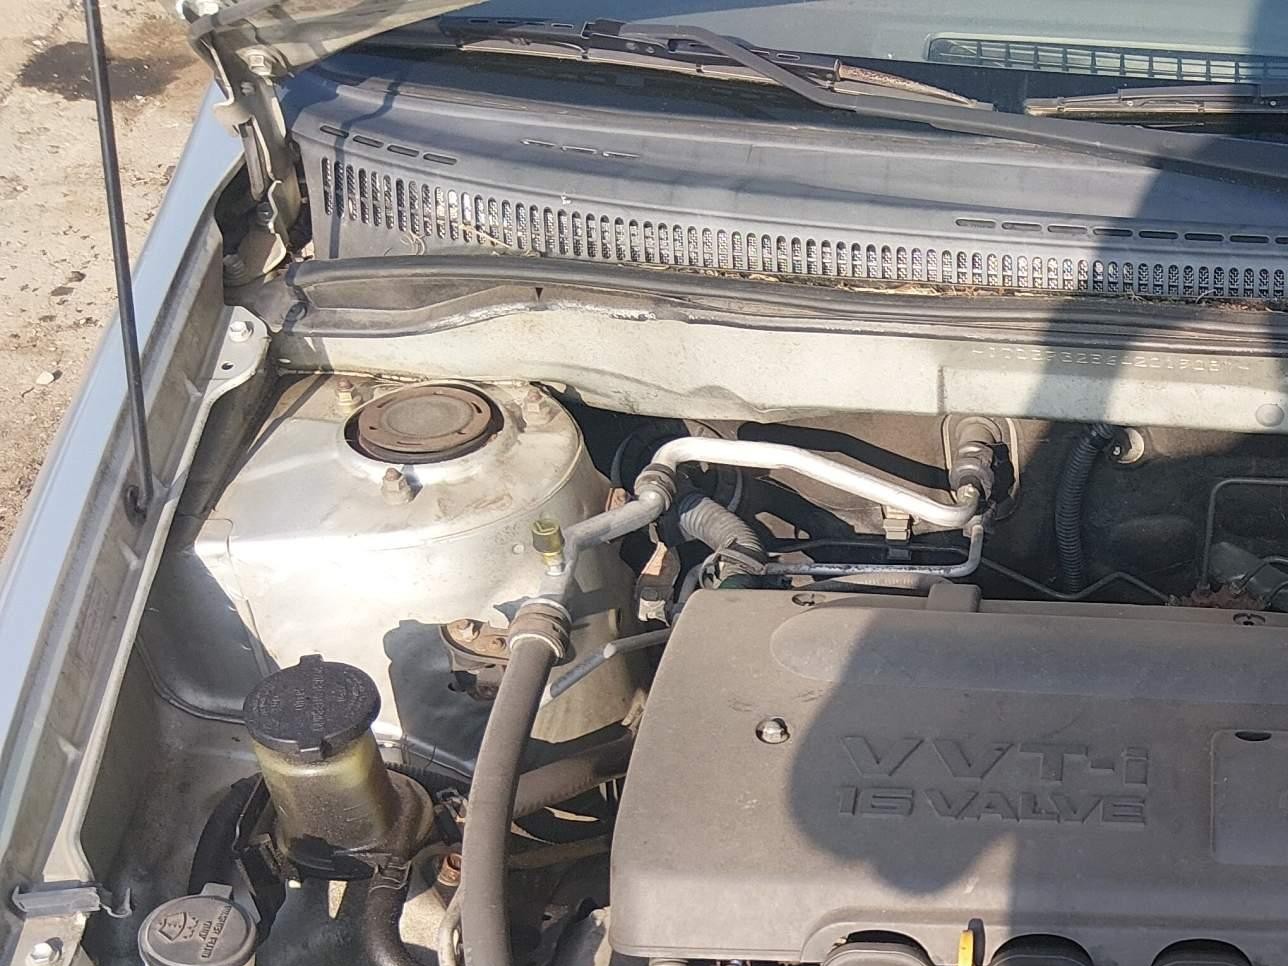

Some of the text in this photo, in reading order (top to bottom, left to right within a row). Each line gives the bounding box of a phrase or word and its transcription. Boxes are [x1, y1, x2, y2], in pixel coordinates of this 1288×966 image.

[842, 735, 1149, 786] VVT-i
[838, 786, 1148, 826] 16 VALVE
